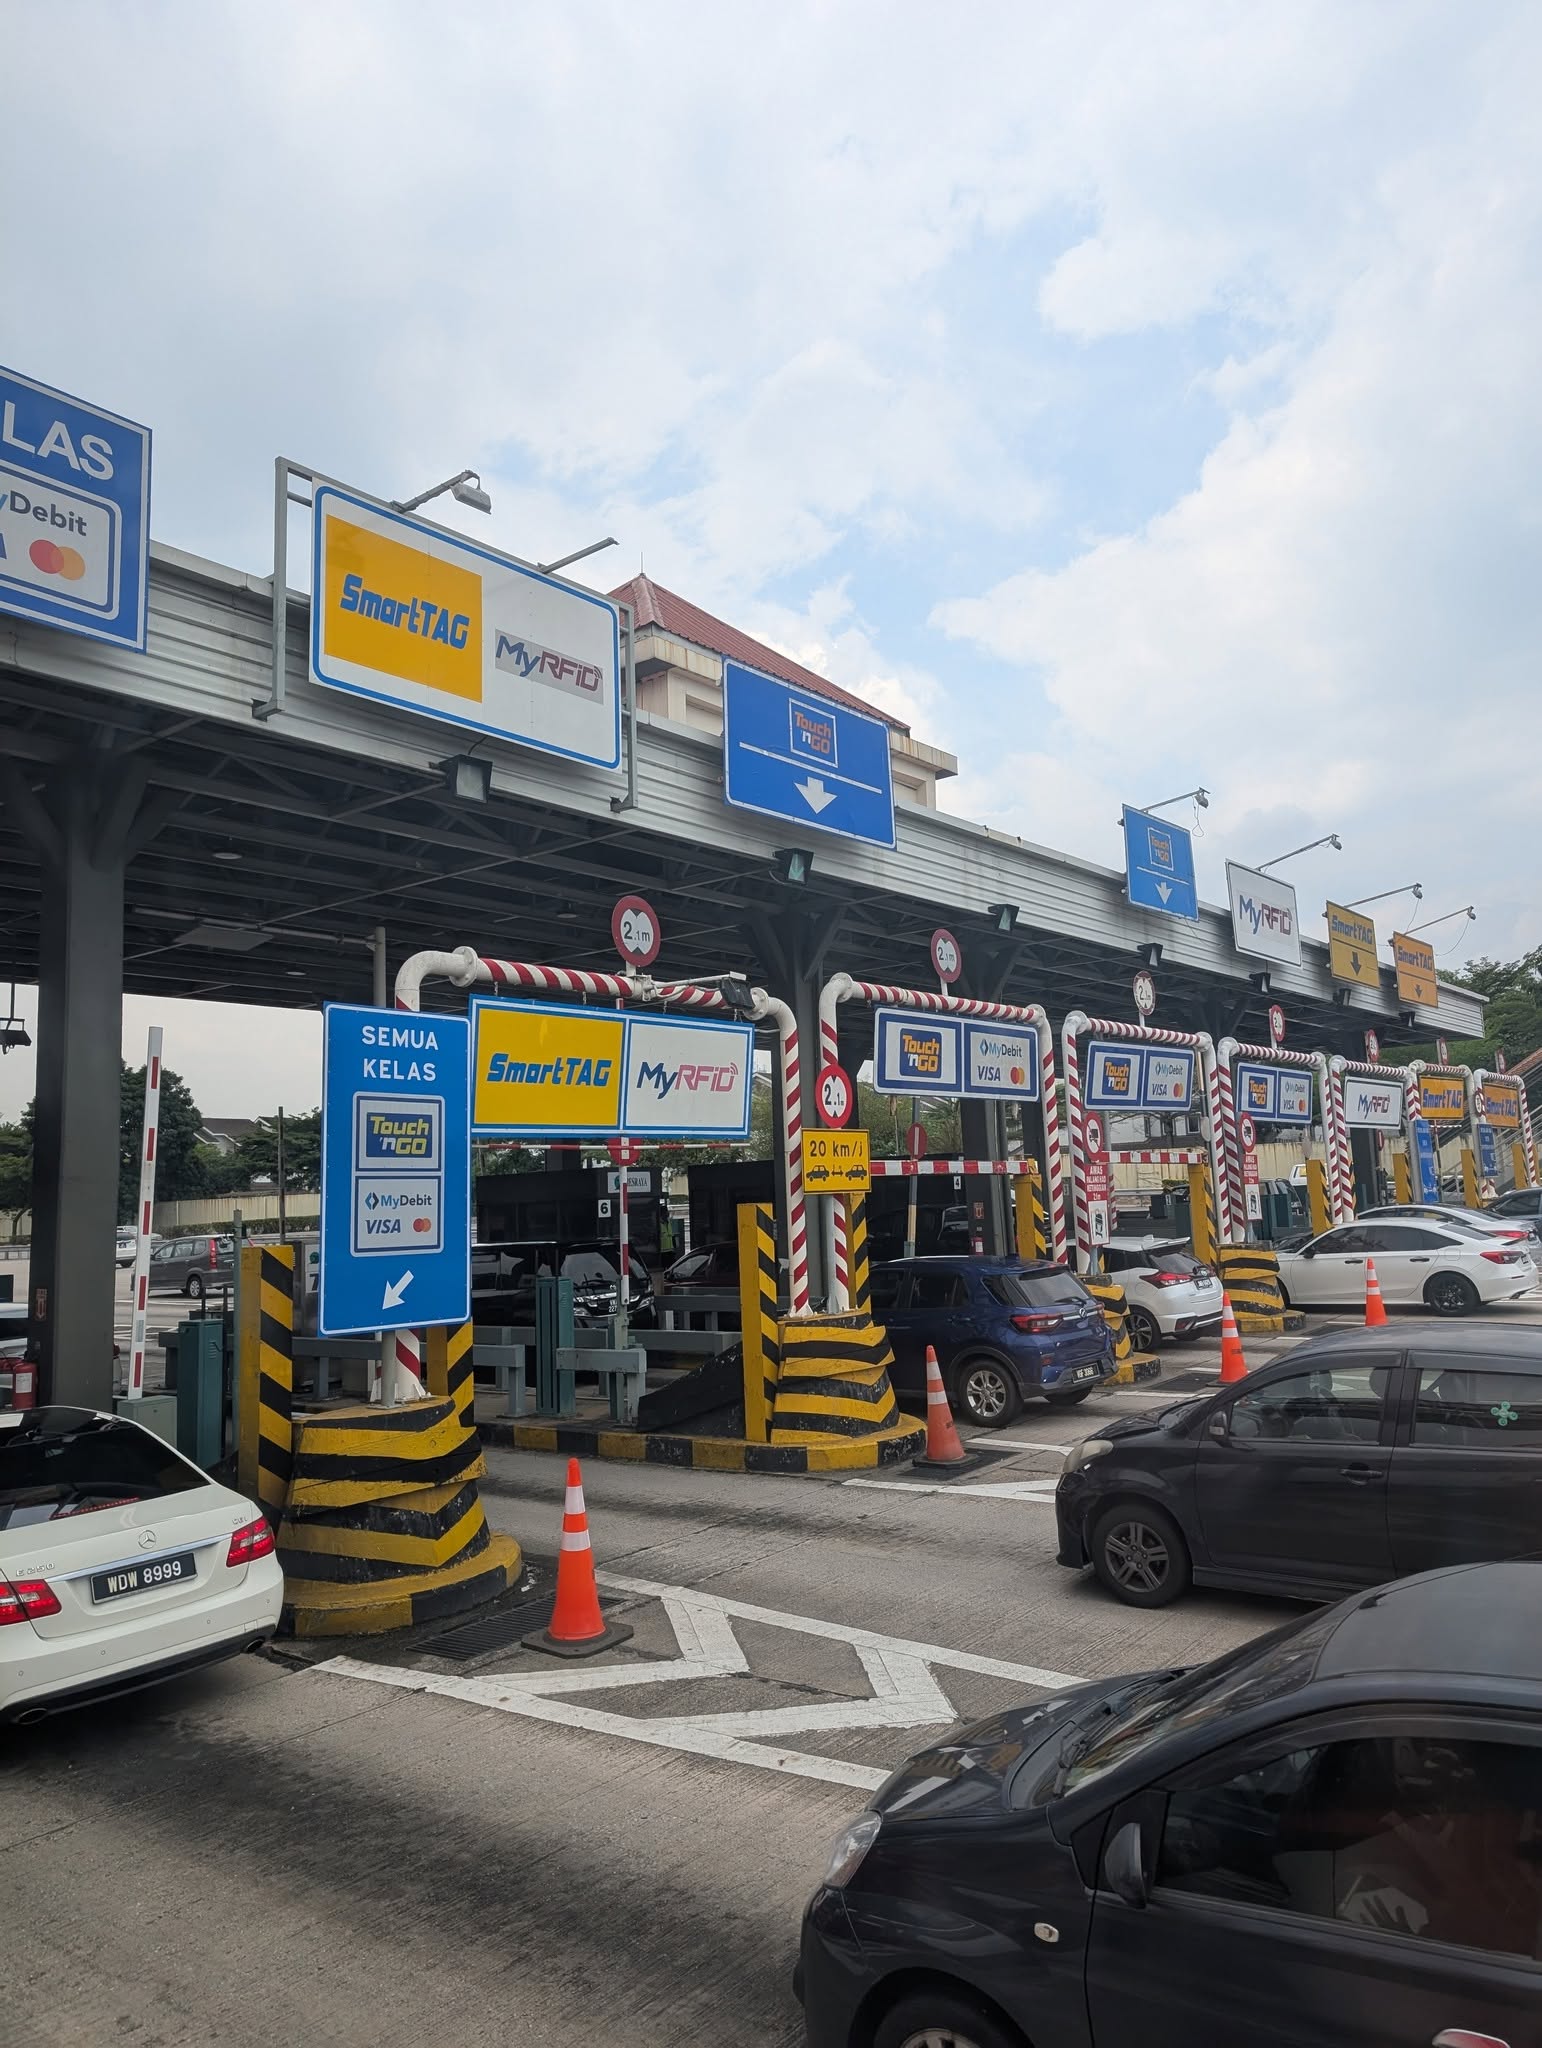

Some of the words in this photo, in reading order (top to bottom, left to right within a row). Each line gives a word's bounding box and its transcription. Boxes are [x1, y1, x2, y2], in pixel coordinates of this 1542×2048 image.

[340, 573, 470, 650] SmartTAG
[794, 711, 832, 739] Touch
[1331, 914, 1374, 945] SmartTAG
[361, 1025, 439, 1051] SEMUA
[902, 1033, 941, 1056] Touch
[988, 1043, 1023, 1059] MyDebit
[363, 1058, 437, 1082] KELAS
[487, 1053, 613, 1088] SmartTAG
[977, 1065, 1001, 1081] VISA
[1104, 1061, 1130, 1077] Touch
[1151, 1083, 1168, 1096] VISA
[1423, 1088, 1462, 1109] SmartTAG
[370, 1116, 430, 1136] Touch
[809, 1140, 827, 1157] 20
[832, 1140, 863, 1158] km/j
[380, 1194, 432, 1210] MyDebit
[600, 1202, 609, 1215] 6
[365, 1218, 401, 1235] VISA
[107, 1570, 138, 1594] WDW
[142, 1560, 183, 1585] 8999
